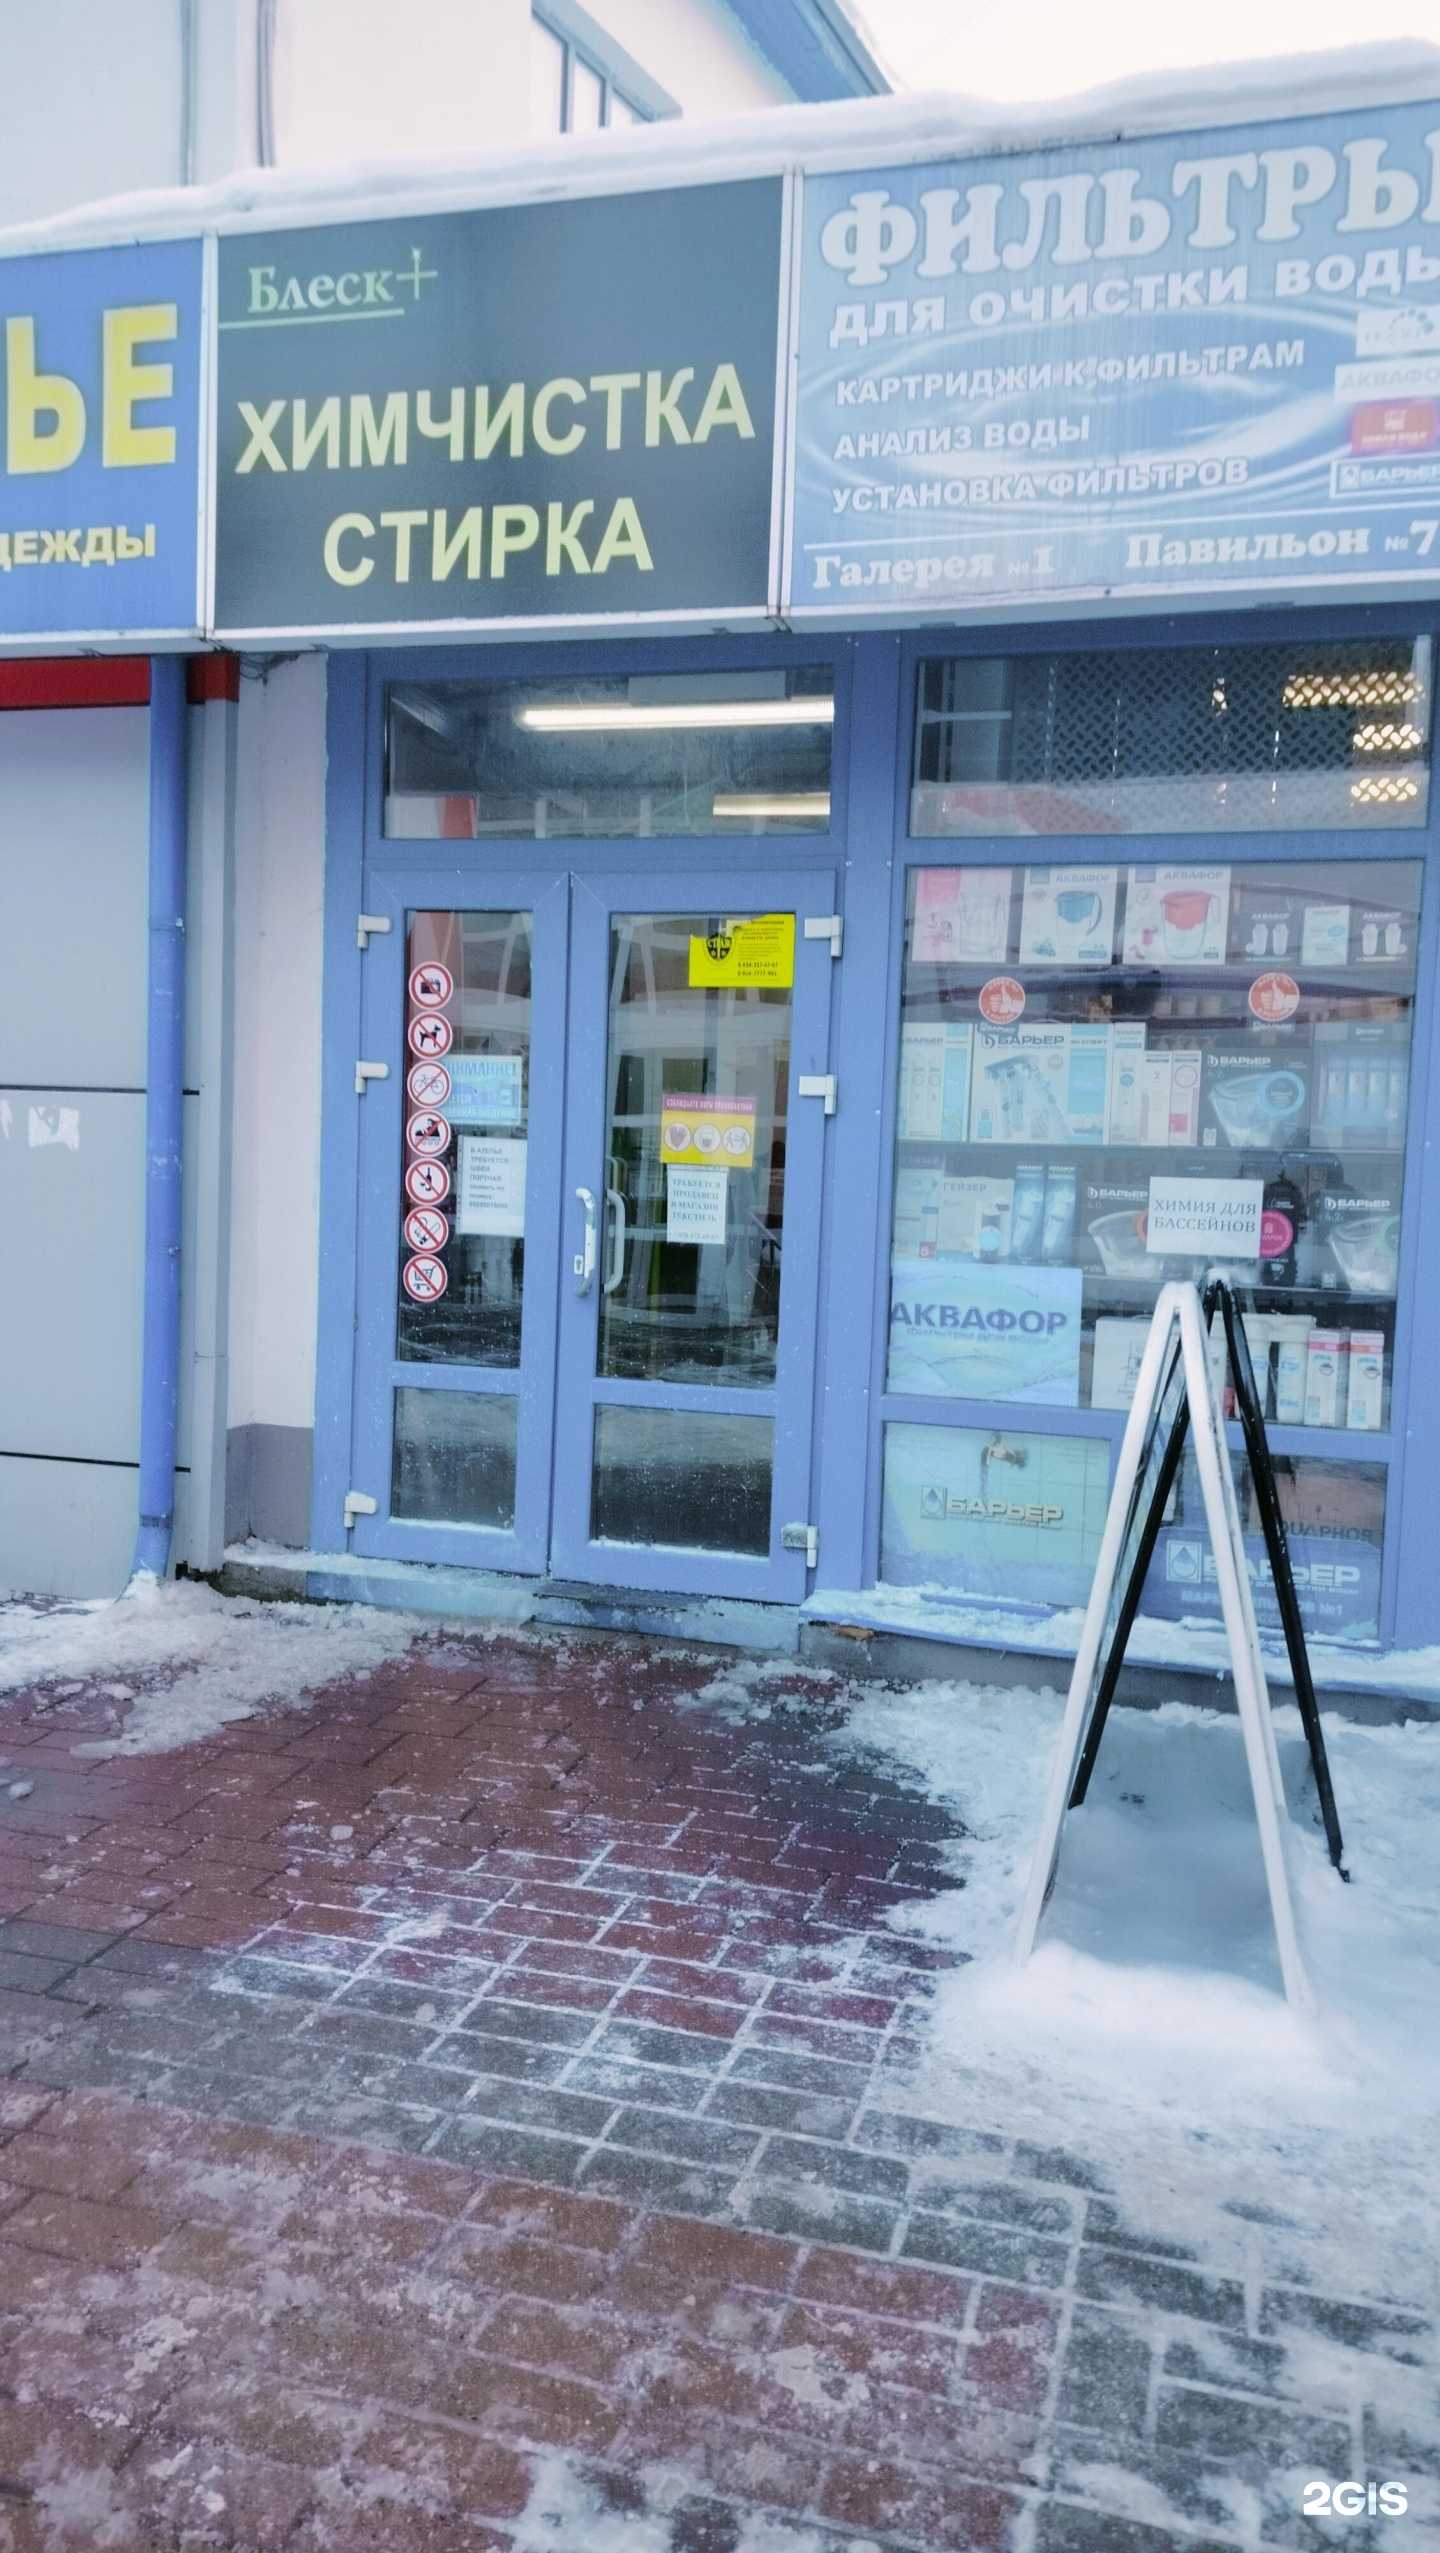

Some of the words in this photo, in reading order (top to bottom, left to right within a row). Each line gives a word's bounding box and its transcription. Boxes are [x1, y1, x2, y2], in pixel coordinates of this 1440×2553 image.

[5, 303, 178, 475] ЬЕ
[836, 366, 1053, 406] КАРТРИДЖИ
[1064, 361, 1087, 387] К
[1098, 340, 1305, 383] ФИЛЬТРАМ
[235, 363, 756, 475] ХИМЧИСТКА
[834, 427, 973, 461] АНАЛИЗ
[984, 415, 1091, 449] ВОДЫ
[832, 472, 1037, 513] УСТАНОВКА
[1047, 457, 1249, 498] ФИЛЬТРОВ
[323, 496, 655, 587] СТИРКА
[1125, 527, 1370, 569] Павильон
[812, 552, 995, 590] Галерея
[997, 1034, 1065, 1046] БАРЬЕР
[1153, 1199, 1216, 1213] ХИМИЯ
[1220, 1202, 1257, 1217] ДЛЯ
[1154, 1215, 1257, 1233] БАССЕЙНОВ
[890, 1302, 1068, 1336] АКВАФОР
[946, 1496, 1065, 1525] БАРЬЕР
